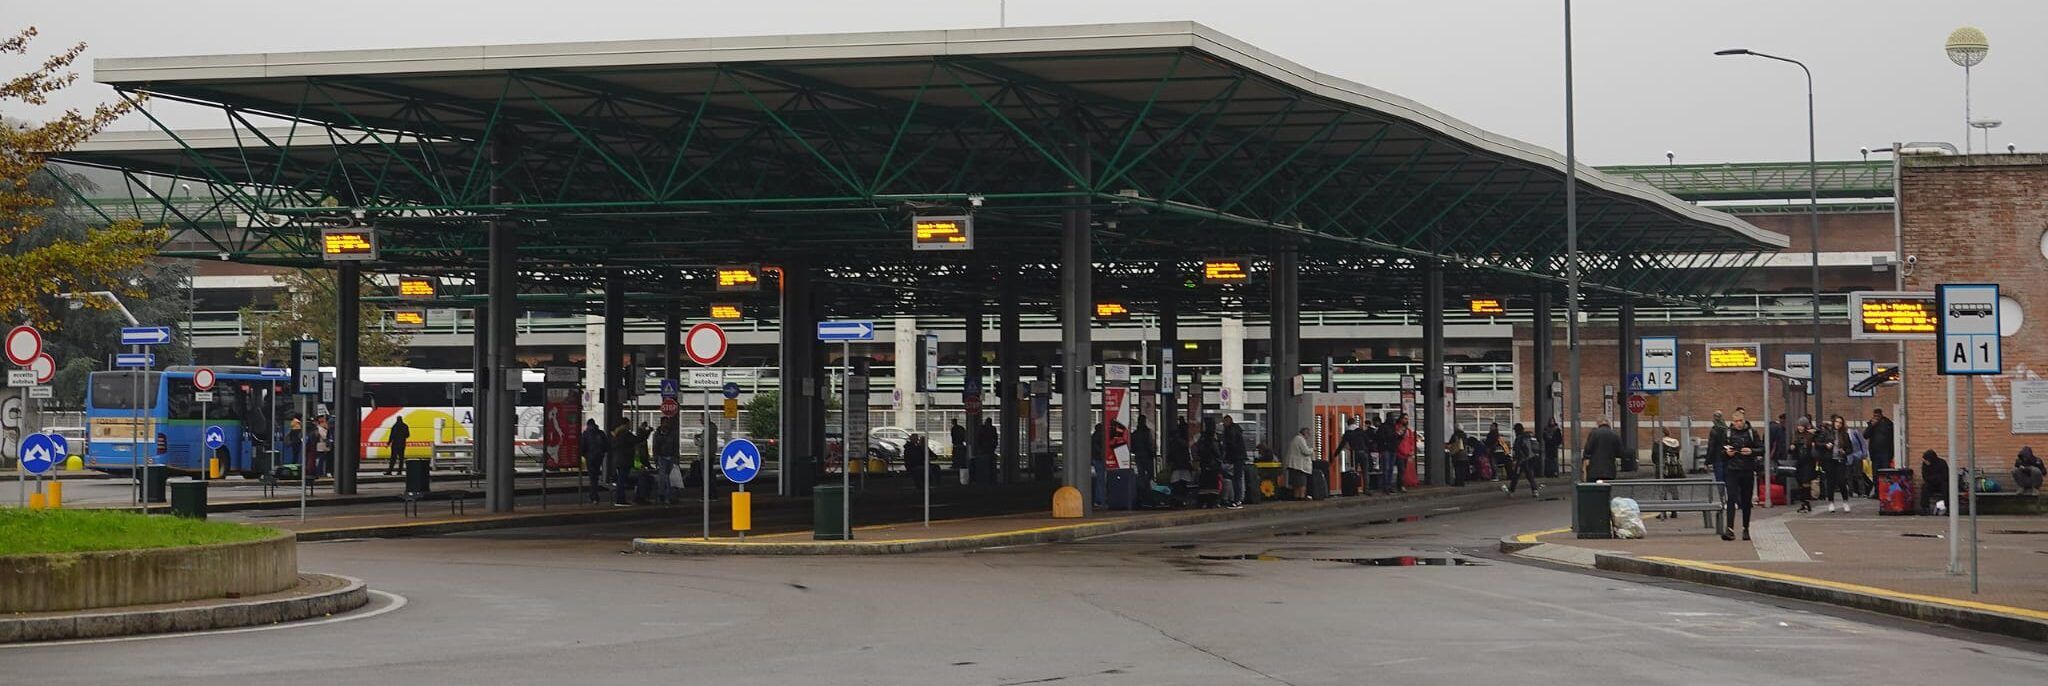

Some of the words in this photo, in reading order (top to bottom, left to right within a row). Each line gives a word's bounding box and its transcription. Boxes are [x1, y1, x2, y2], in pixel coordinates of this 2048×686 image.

[1953, 342, 1967, 363] A
[1979, 342, 1988, 363] 1
[302, 374, 308, 388] C
[311, 375, 316, 388] 1
[1647, 372, 1656, 385] A
[1664, 371, 1672, 384] 2
[1628, 400, 1645, 408] STOP
